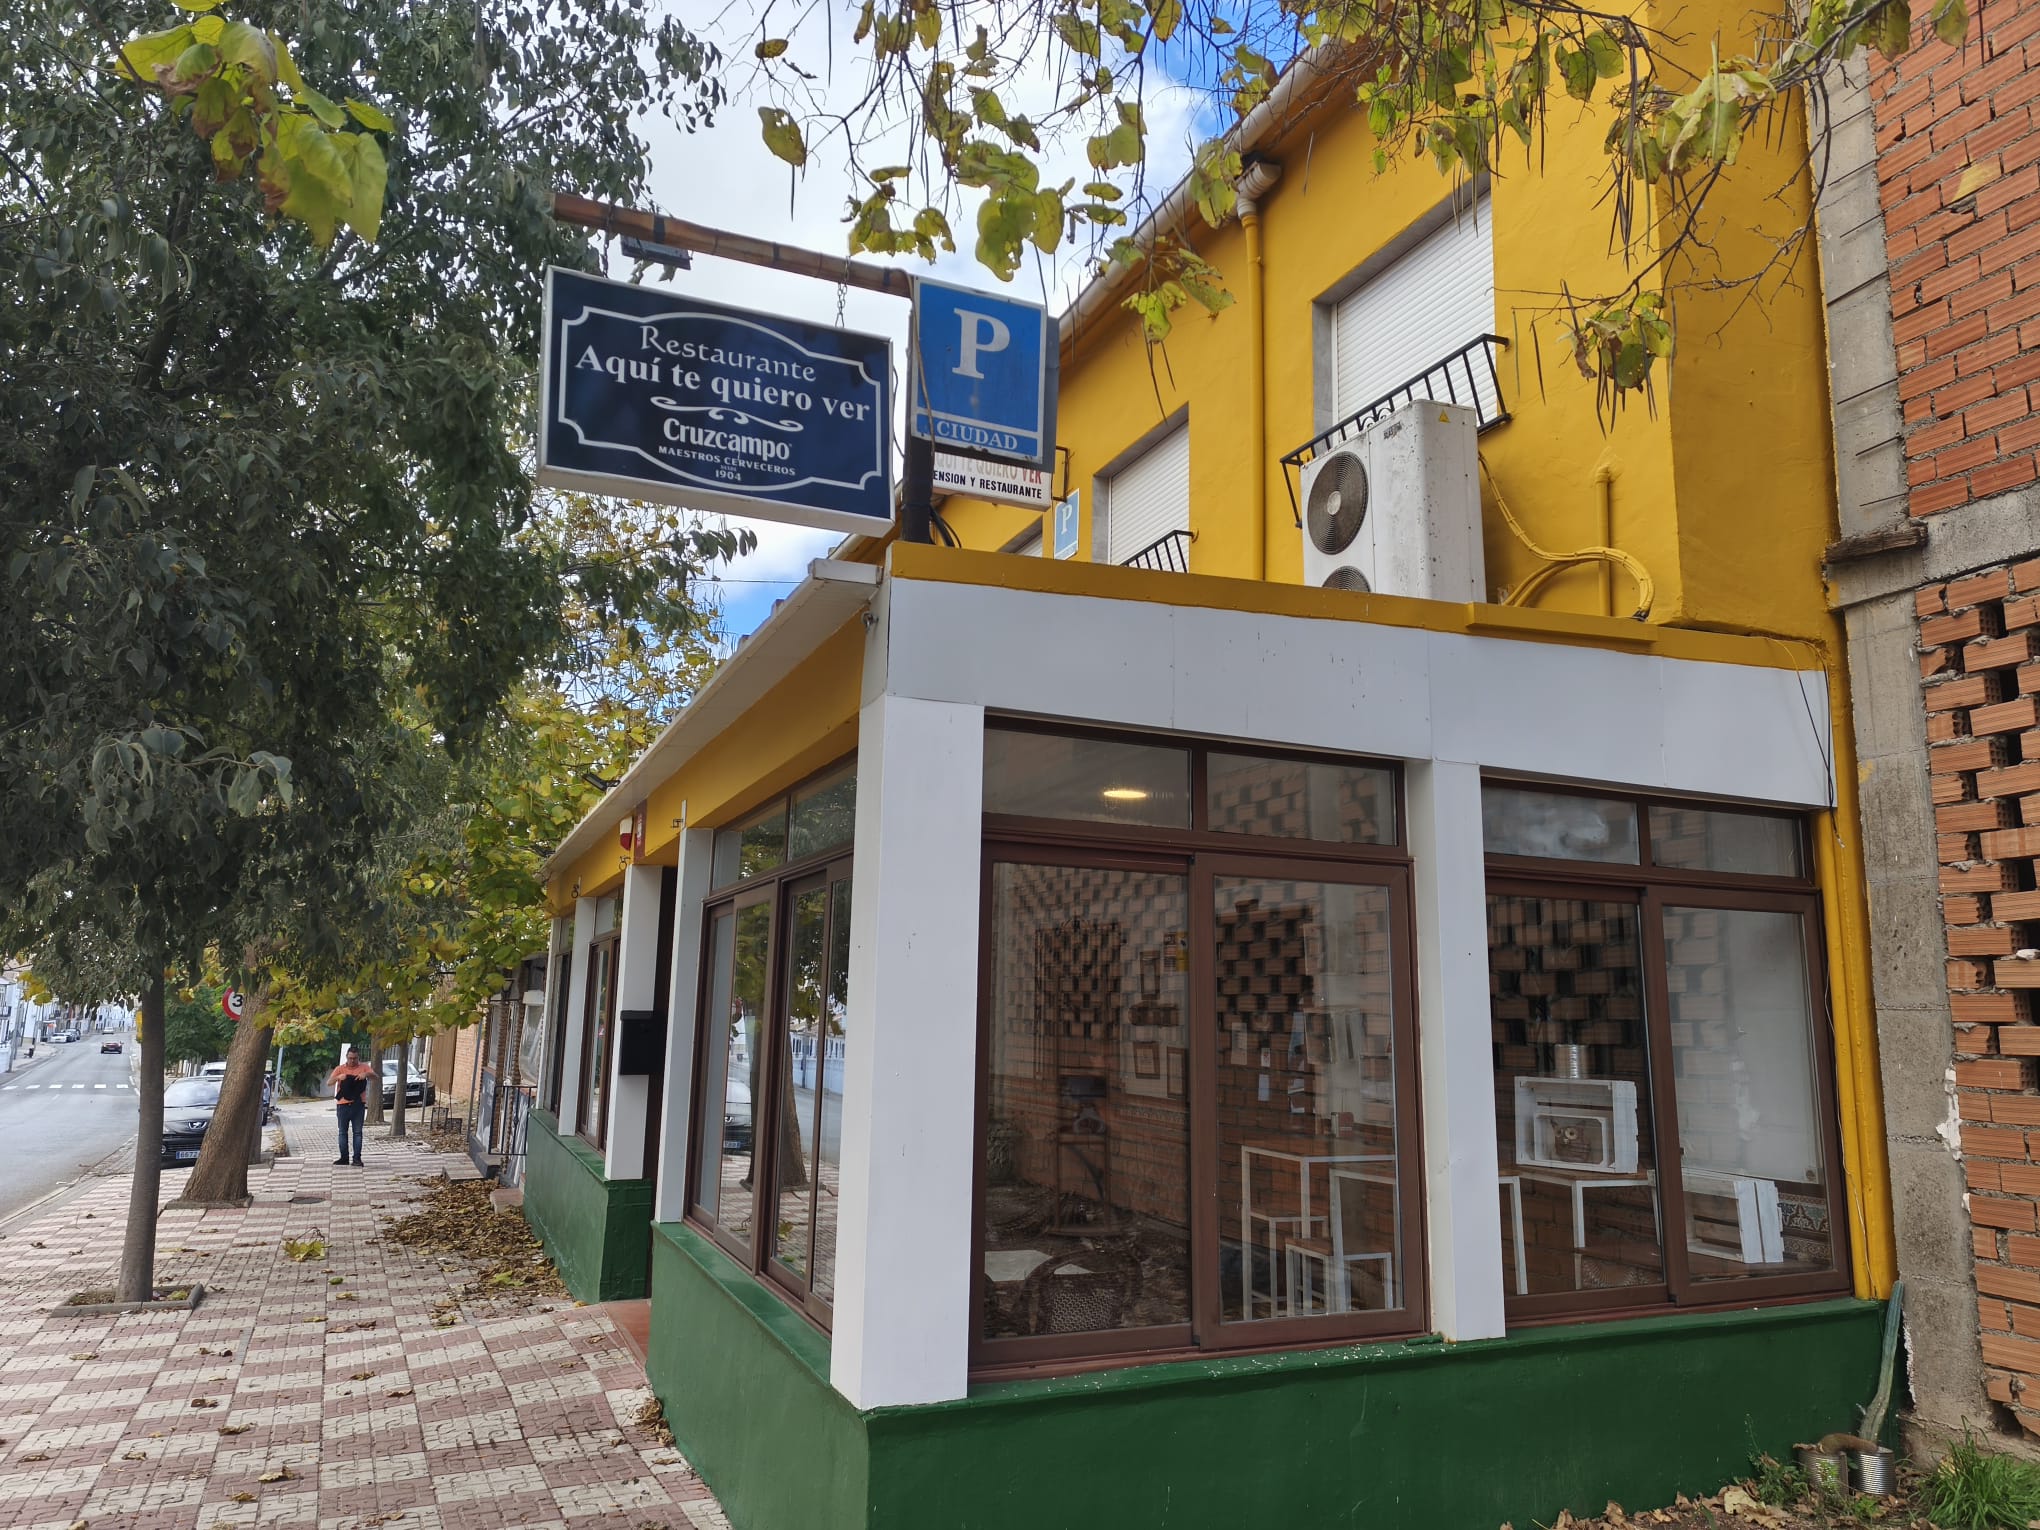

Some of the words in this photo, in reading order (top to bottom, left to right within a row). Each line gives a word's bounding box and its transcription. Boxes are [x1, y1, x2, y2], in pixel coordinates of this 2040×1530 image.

[639, 325, 817, 382] Restaurante
[952, 307, 1011, 380] P
[575, 344, 661, 384] Aquí
[671, 363, 701, 390] te
[711, 376, 812, 412] quiero
[821, 395, 871, 421] ver
[663, 417, 790, 462] Cruzcampo
[936, 420, 1018, 450] CIUDAD
[658, 445, 721, 464] MAESTROS
[724, 456, 796, 476] CERVECEROS
[715, 469, 742, 481] 1904
[936, 453, 957, 469] QUI
[1021, 466, 1042, 485] VER
[933, 470, 966, 485] ENSION
[970, 477, 976, 487] Y
[979, 478, 1042, 499] RESTAURANTE
[1061, 504, 1073, 535] P
[232, 994, 243, 1007] 3
